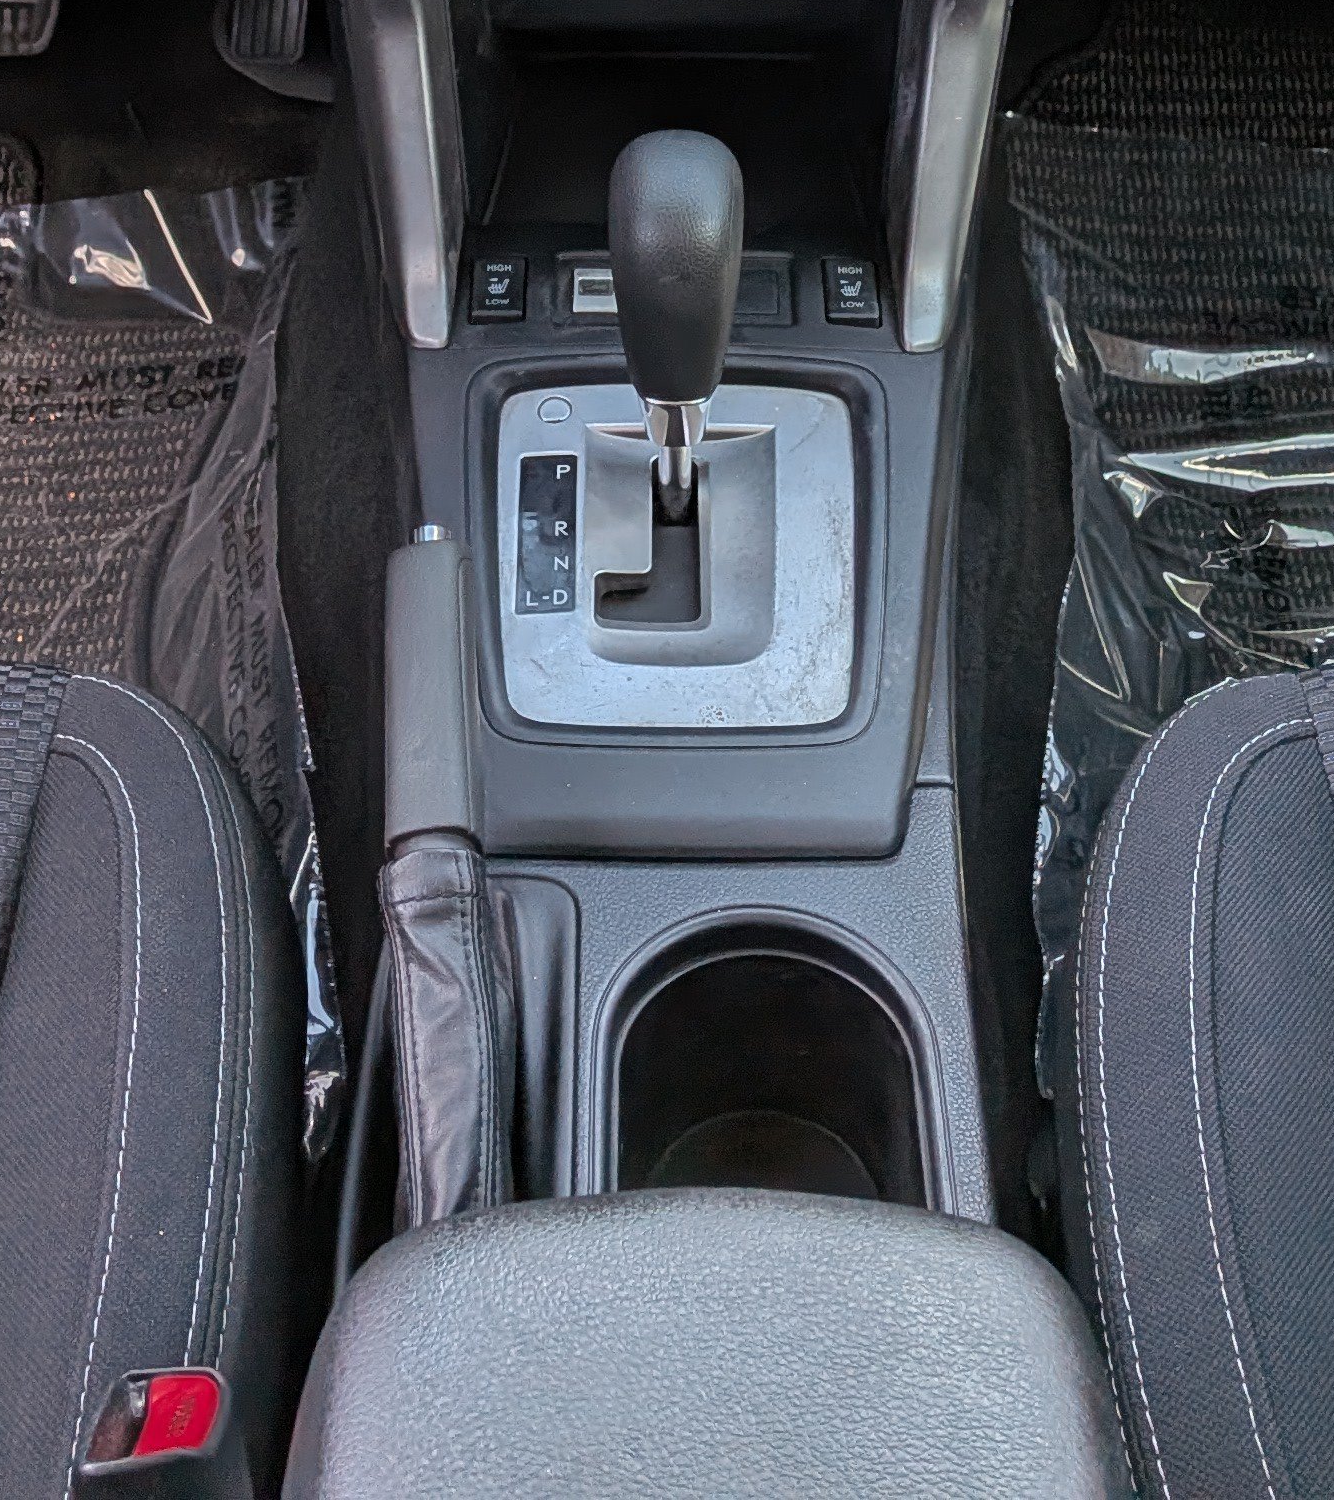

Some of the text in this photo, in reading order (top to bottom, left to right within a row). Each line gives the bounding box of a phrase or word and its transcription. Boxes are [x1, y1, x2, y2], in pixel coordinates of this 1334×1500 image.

[486, 264, 512, 272] HIGH
[837, 266, 863, 274] HIGH
[485, 298, 510, 306] LOW
[555, 463, 572, 480] P
[553, 520, 569, 537] R
[553, 555, 569, 572] N
